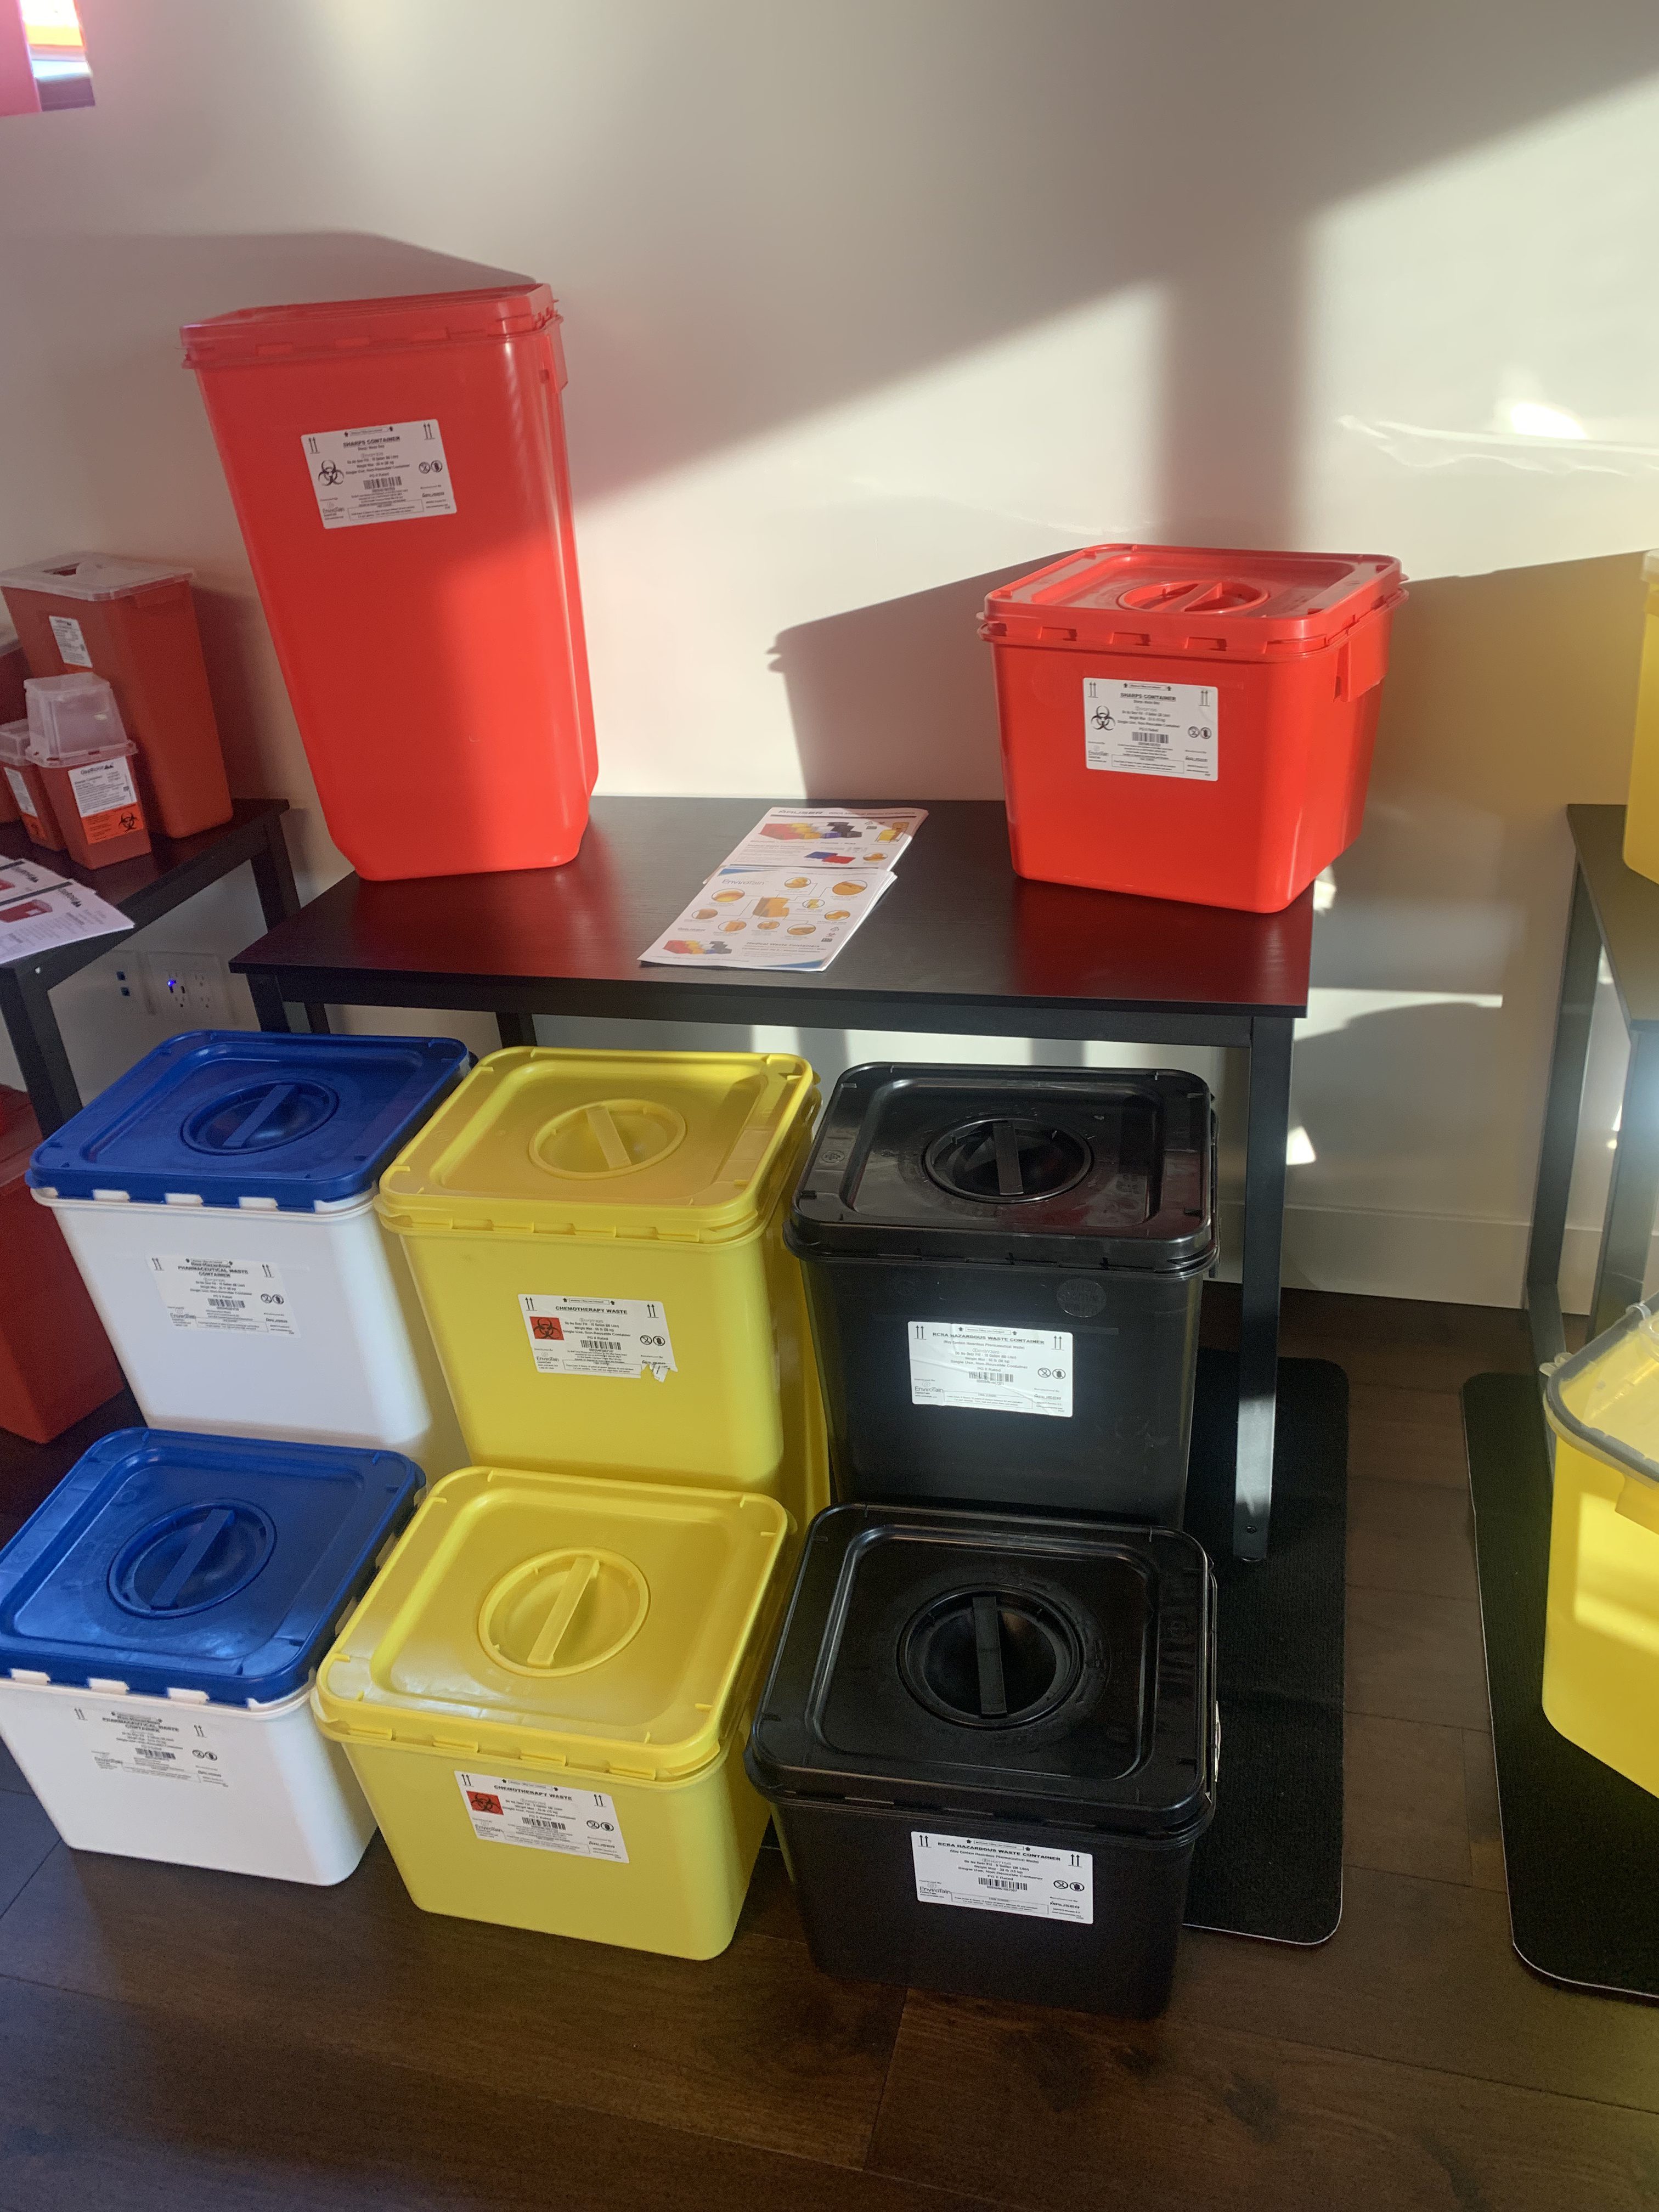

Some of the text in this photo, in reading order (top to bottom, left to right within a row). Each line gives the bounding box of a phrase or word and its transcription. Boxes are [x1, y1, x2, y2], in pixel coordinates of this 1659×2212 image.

[367, 436, 400, 444] CONTAINER
[494, 1785, 548, 1797] CHEMOTHERAPY
[957, 1844, 997, 1853] HAZARDOUS
[1022, 1853, 1061, 1861] CONTAINER
[919, 1886, 951, 1894] EnviroTain
[1050, 1901, 1080, 1909] MAUSER
